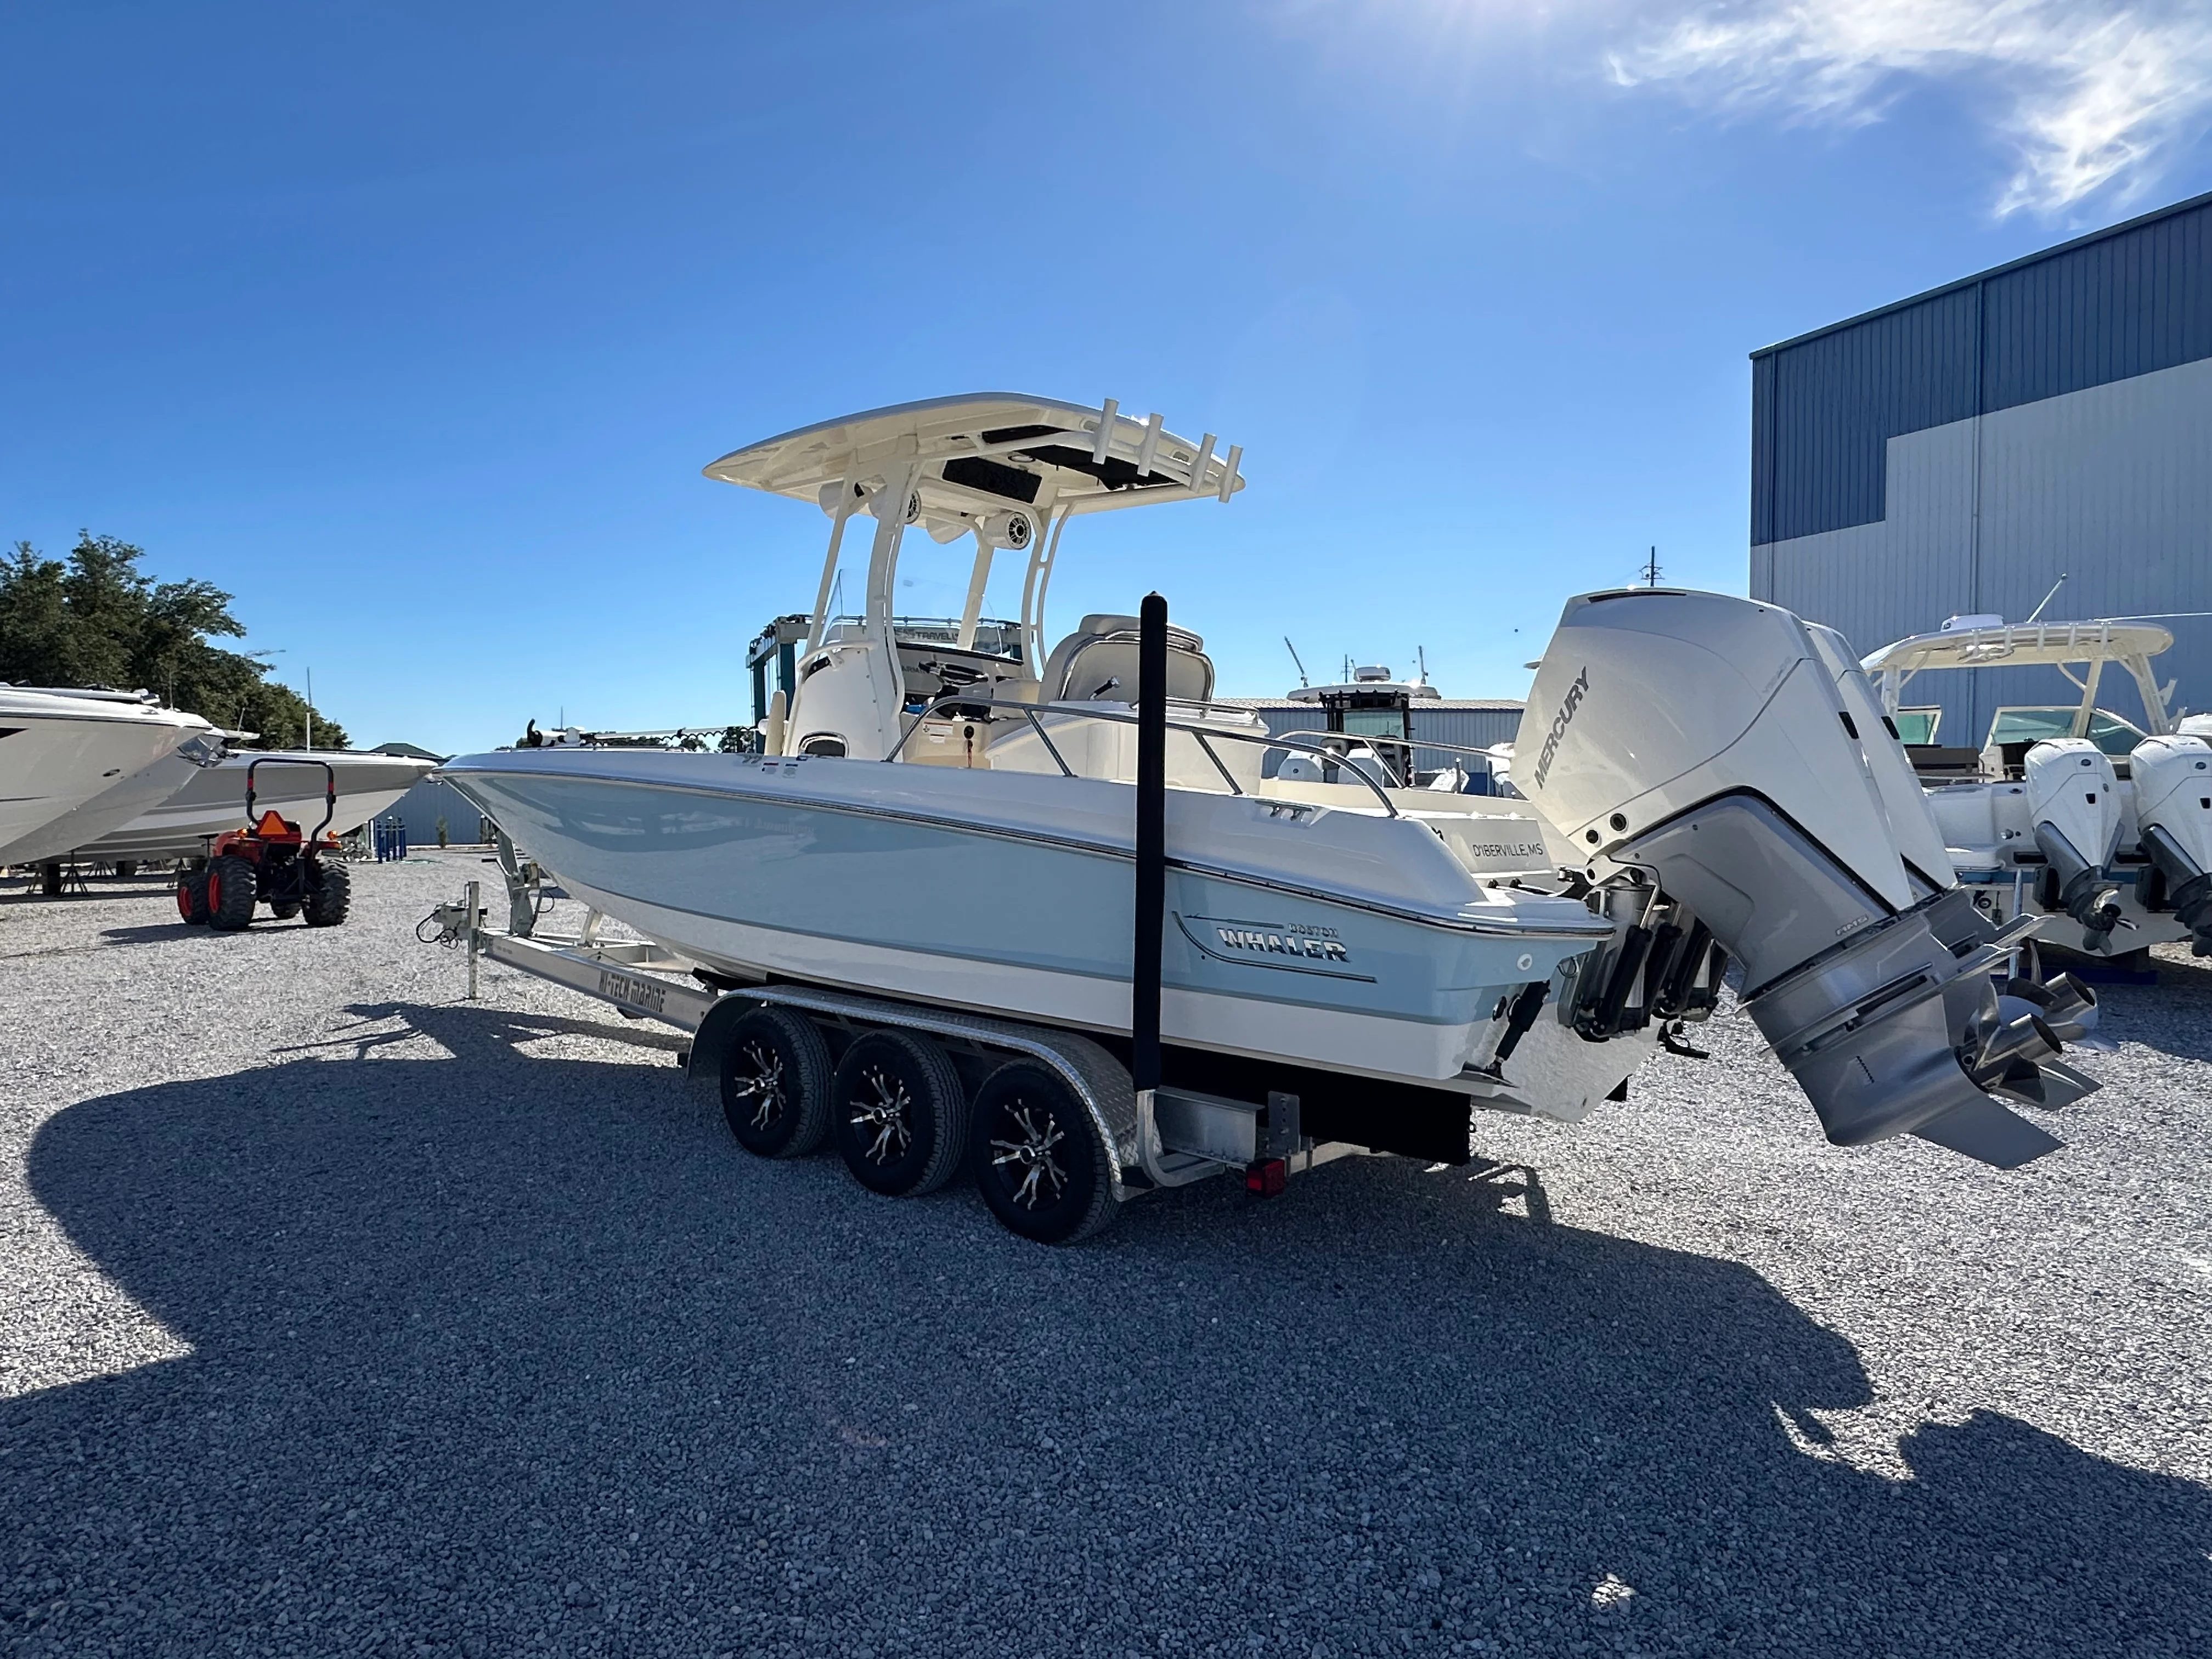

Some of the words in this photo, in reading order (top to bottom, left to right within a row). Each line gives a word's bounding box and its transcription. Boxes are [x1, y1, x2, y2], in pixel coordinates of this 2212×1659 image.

[1534, 665, 1589, 790] MERCURY
[1216, 927, 1351, 963] WHALER
[1289, 923, 1339, 938] BOSTON
